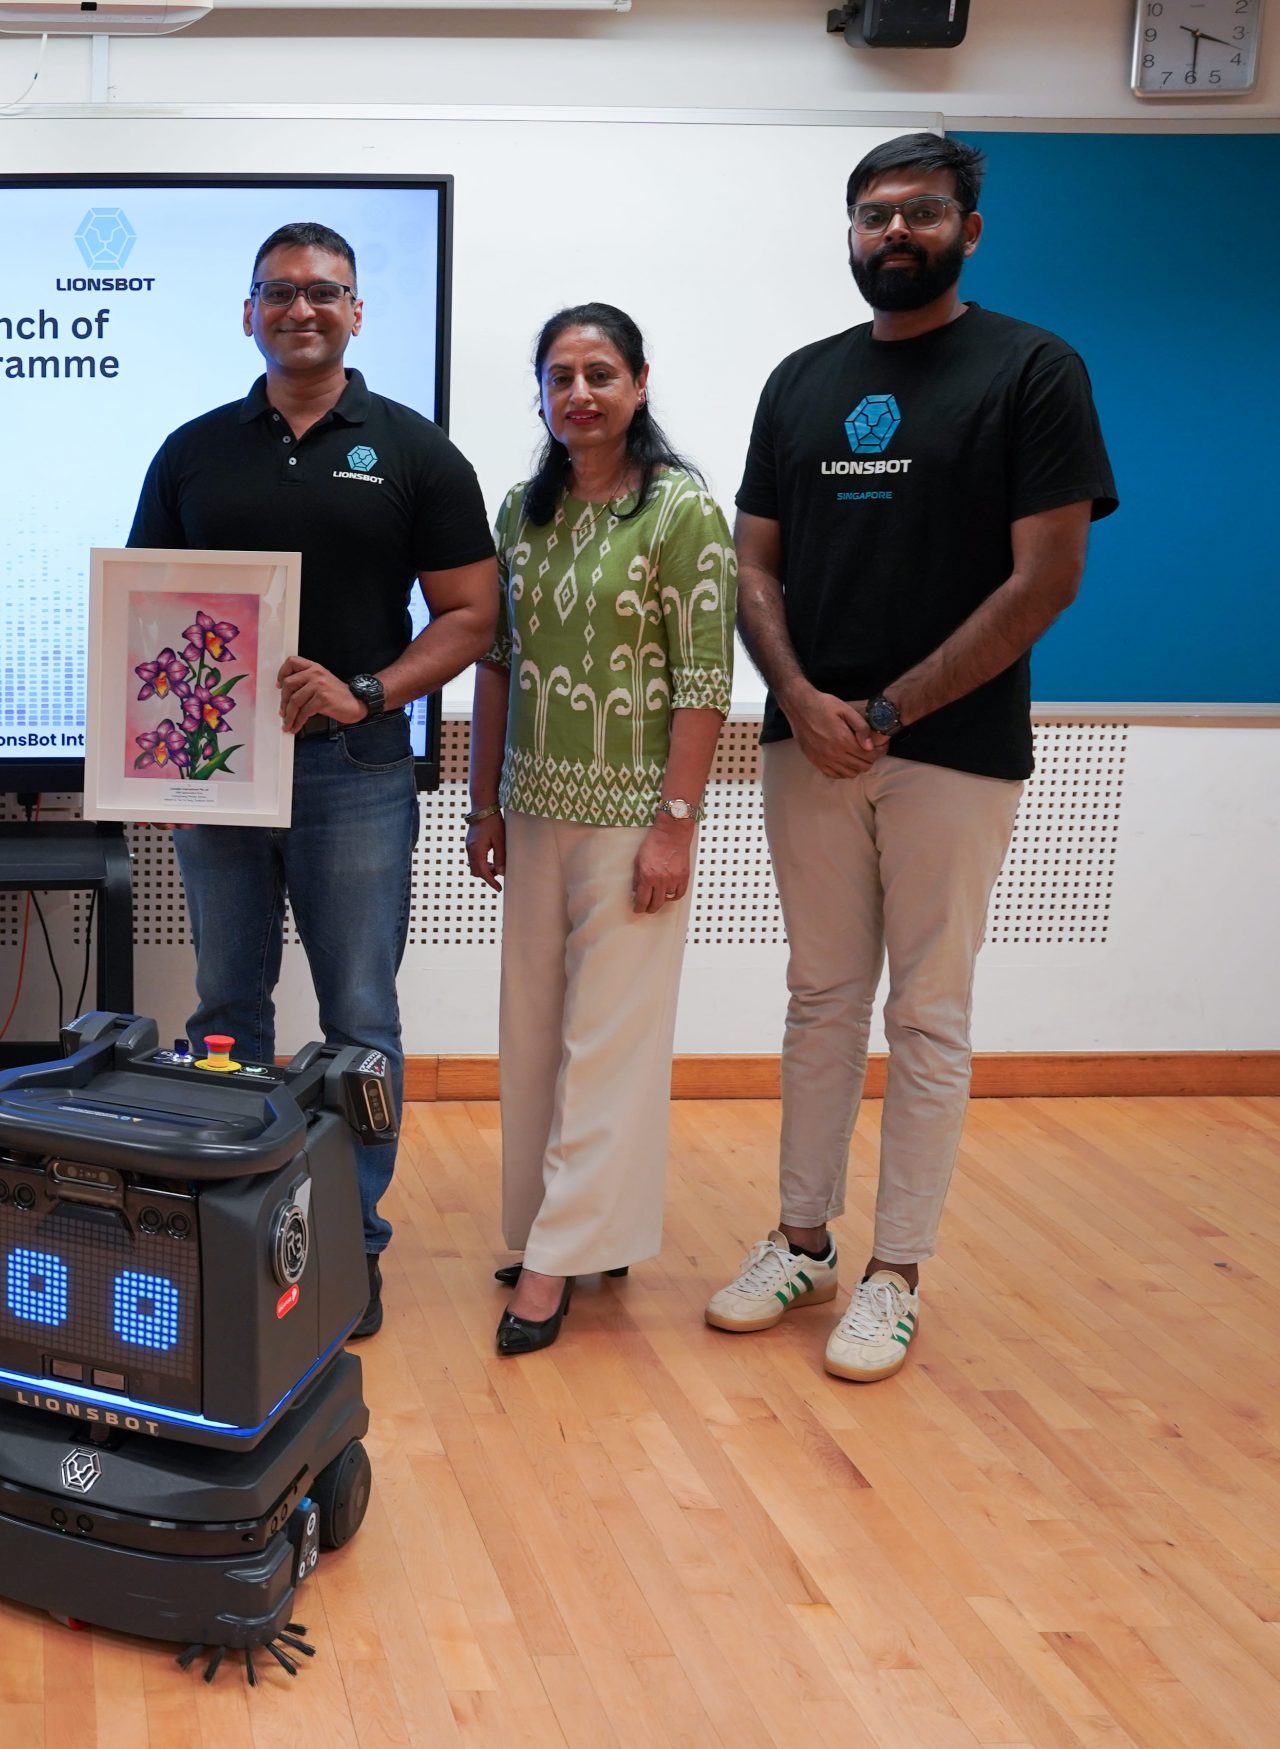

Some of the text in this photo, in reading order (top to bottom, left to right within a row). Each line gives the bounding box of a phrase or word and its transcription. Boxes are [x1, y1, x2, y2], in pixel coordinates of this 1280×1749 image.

[1147, 3, 1163, 17] 10
[1145, 28, 1157, 42] 9
[1232, 26, 1245, 40] 3
[1143, 54, 1155, 68] 8
[1230, 53, 1241, 66] 4
[1161, 71, 1173, 85] 7
[1184, 70, 1197, 84] 6
[1208, 70, 1221, 84] 5
[56, 277, 156, 292] LIONSBOT
[71, 308, 111, 340] of
[821, 459, 913, 475] LIONSBOT
[332, 470, 385, 485] LIONSBOT
[836, 491, 893, 501] SINGAPORE
[286, 1230, 305, 1261] R3
[16, 1390, 160, 1436] LIONSBOT
